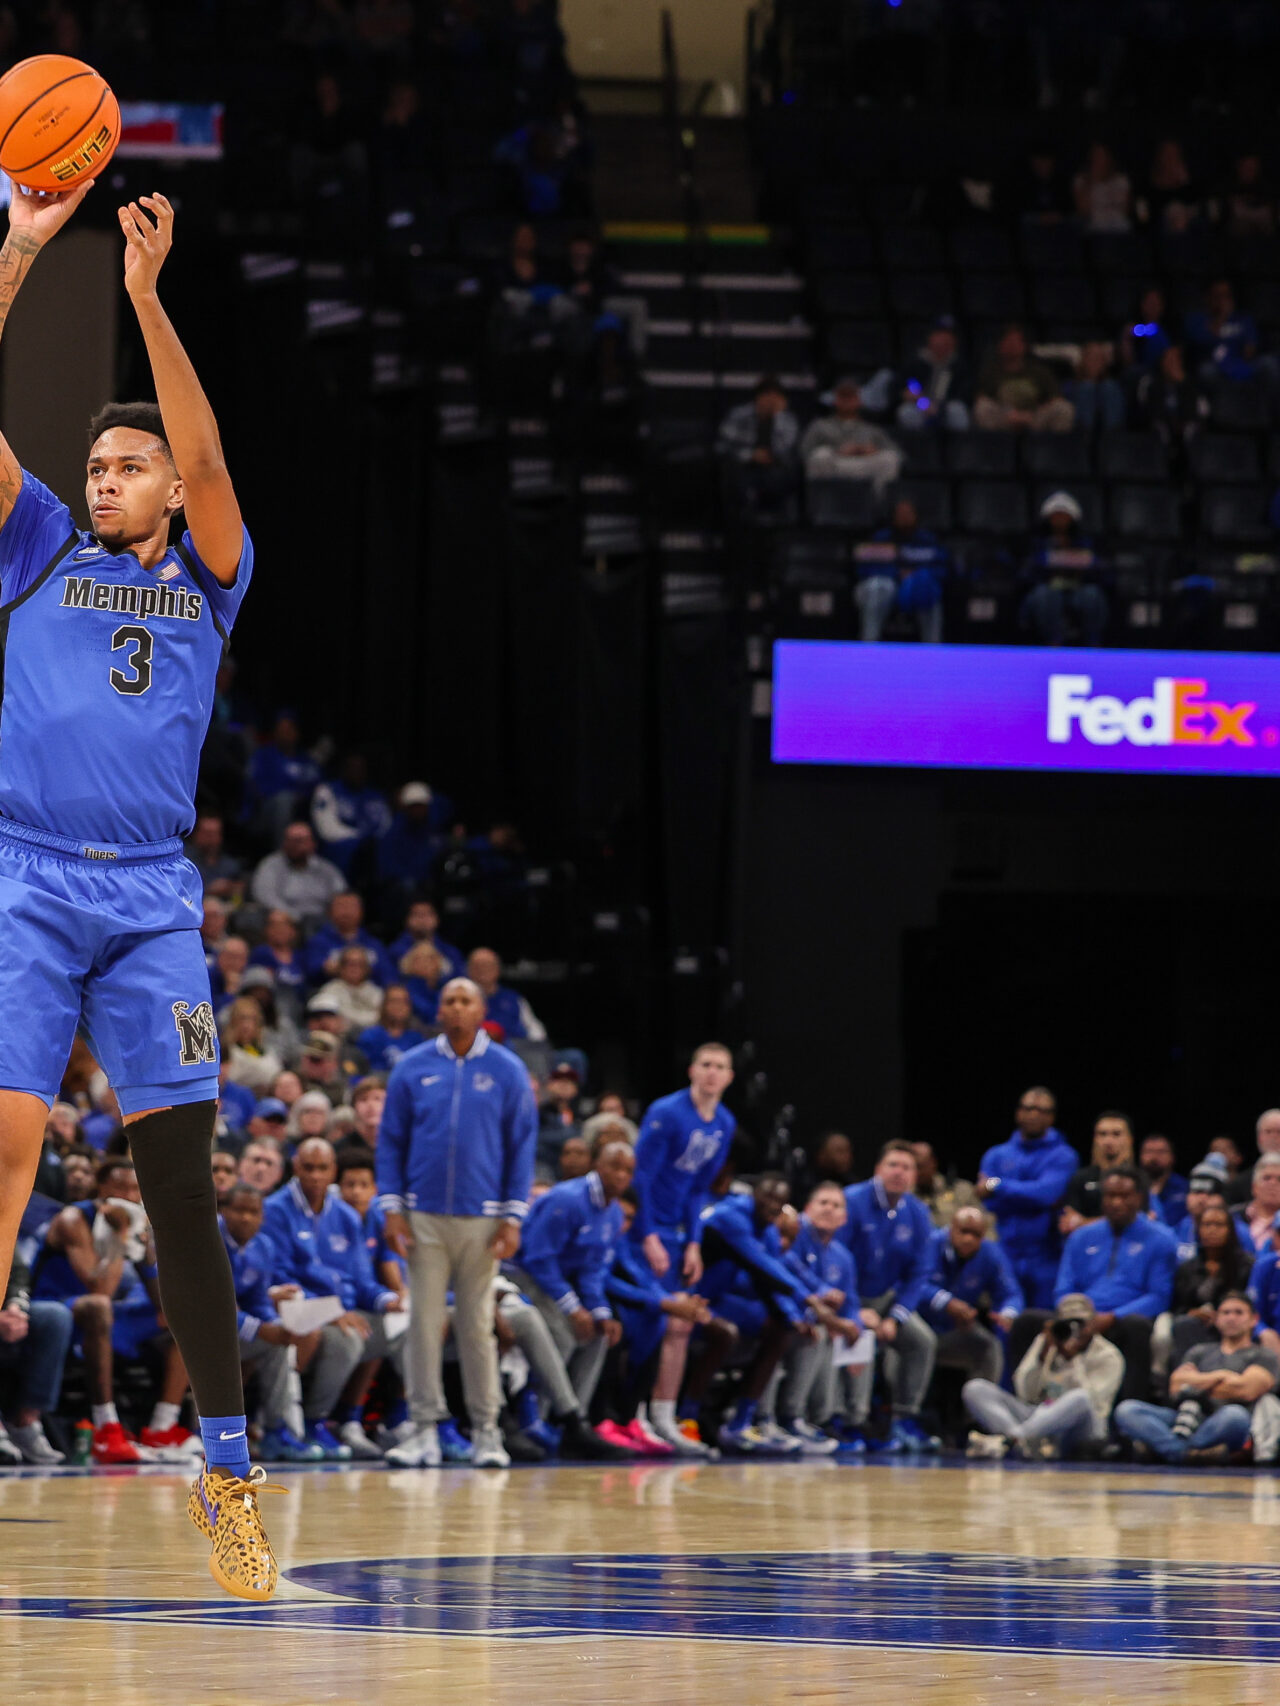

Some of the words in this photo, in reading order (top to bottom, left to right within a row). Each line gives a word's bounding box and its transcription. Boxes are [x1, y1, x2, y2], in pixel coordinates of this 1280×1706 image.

[51, 125, 112, 181] ELITE
[58, 575, 203, 621] Memphis
[109, 624, 154, 697] 3
[1046, 674, 1259, 746] FedEx
[83, 847, 118, 860] Tigers
